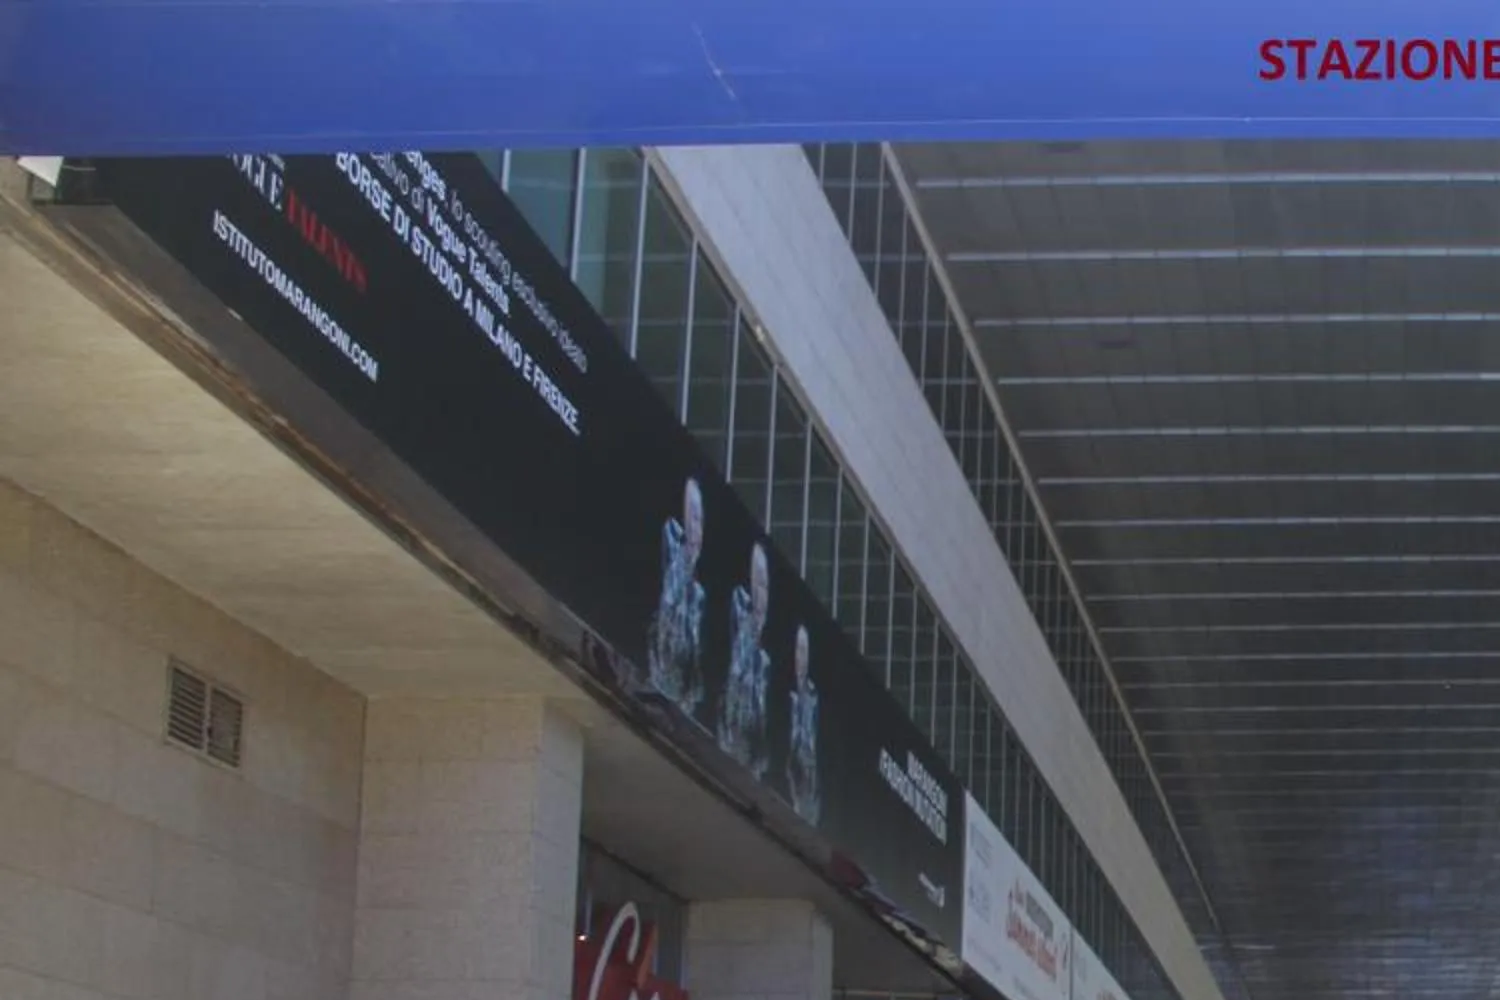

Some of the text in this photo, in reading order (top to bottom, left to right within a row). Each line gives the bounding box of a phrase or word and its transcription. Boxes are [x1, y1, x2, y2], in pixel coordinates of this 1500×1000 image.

[213, 208, 379, 383] ISTITUTOMARANGONI.COM
[336, 151, 392, 223] BORSE
[393, 203, 411, 241] DI
[411, 225, 463, 301] STUDIO
[463, 287, 474, 317] A
[475, 299, 522, 369] MILANO
[522, 353, 533, 382] E
[427, 197, 466, 264] Vogue
